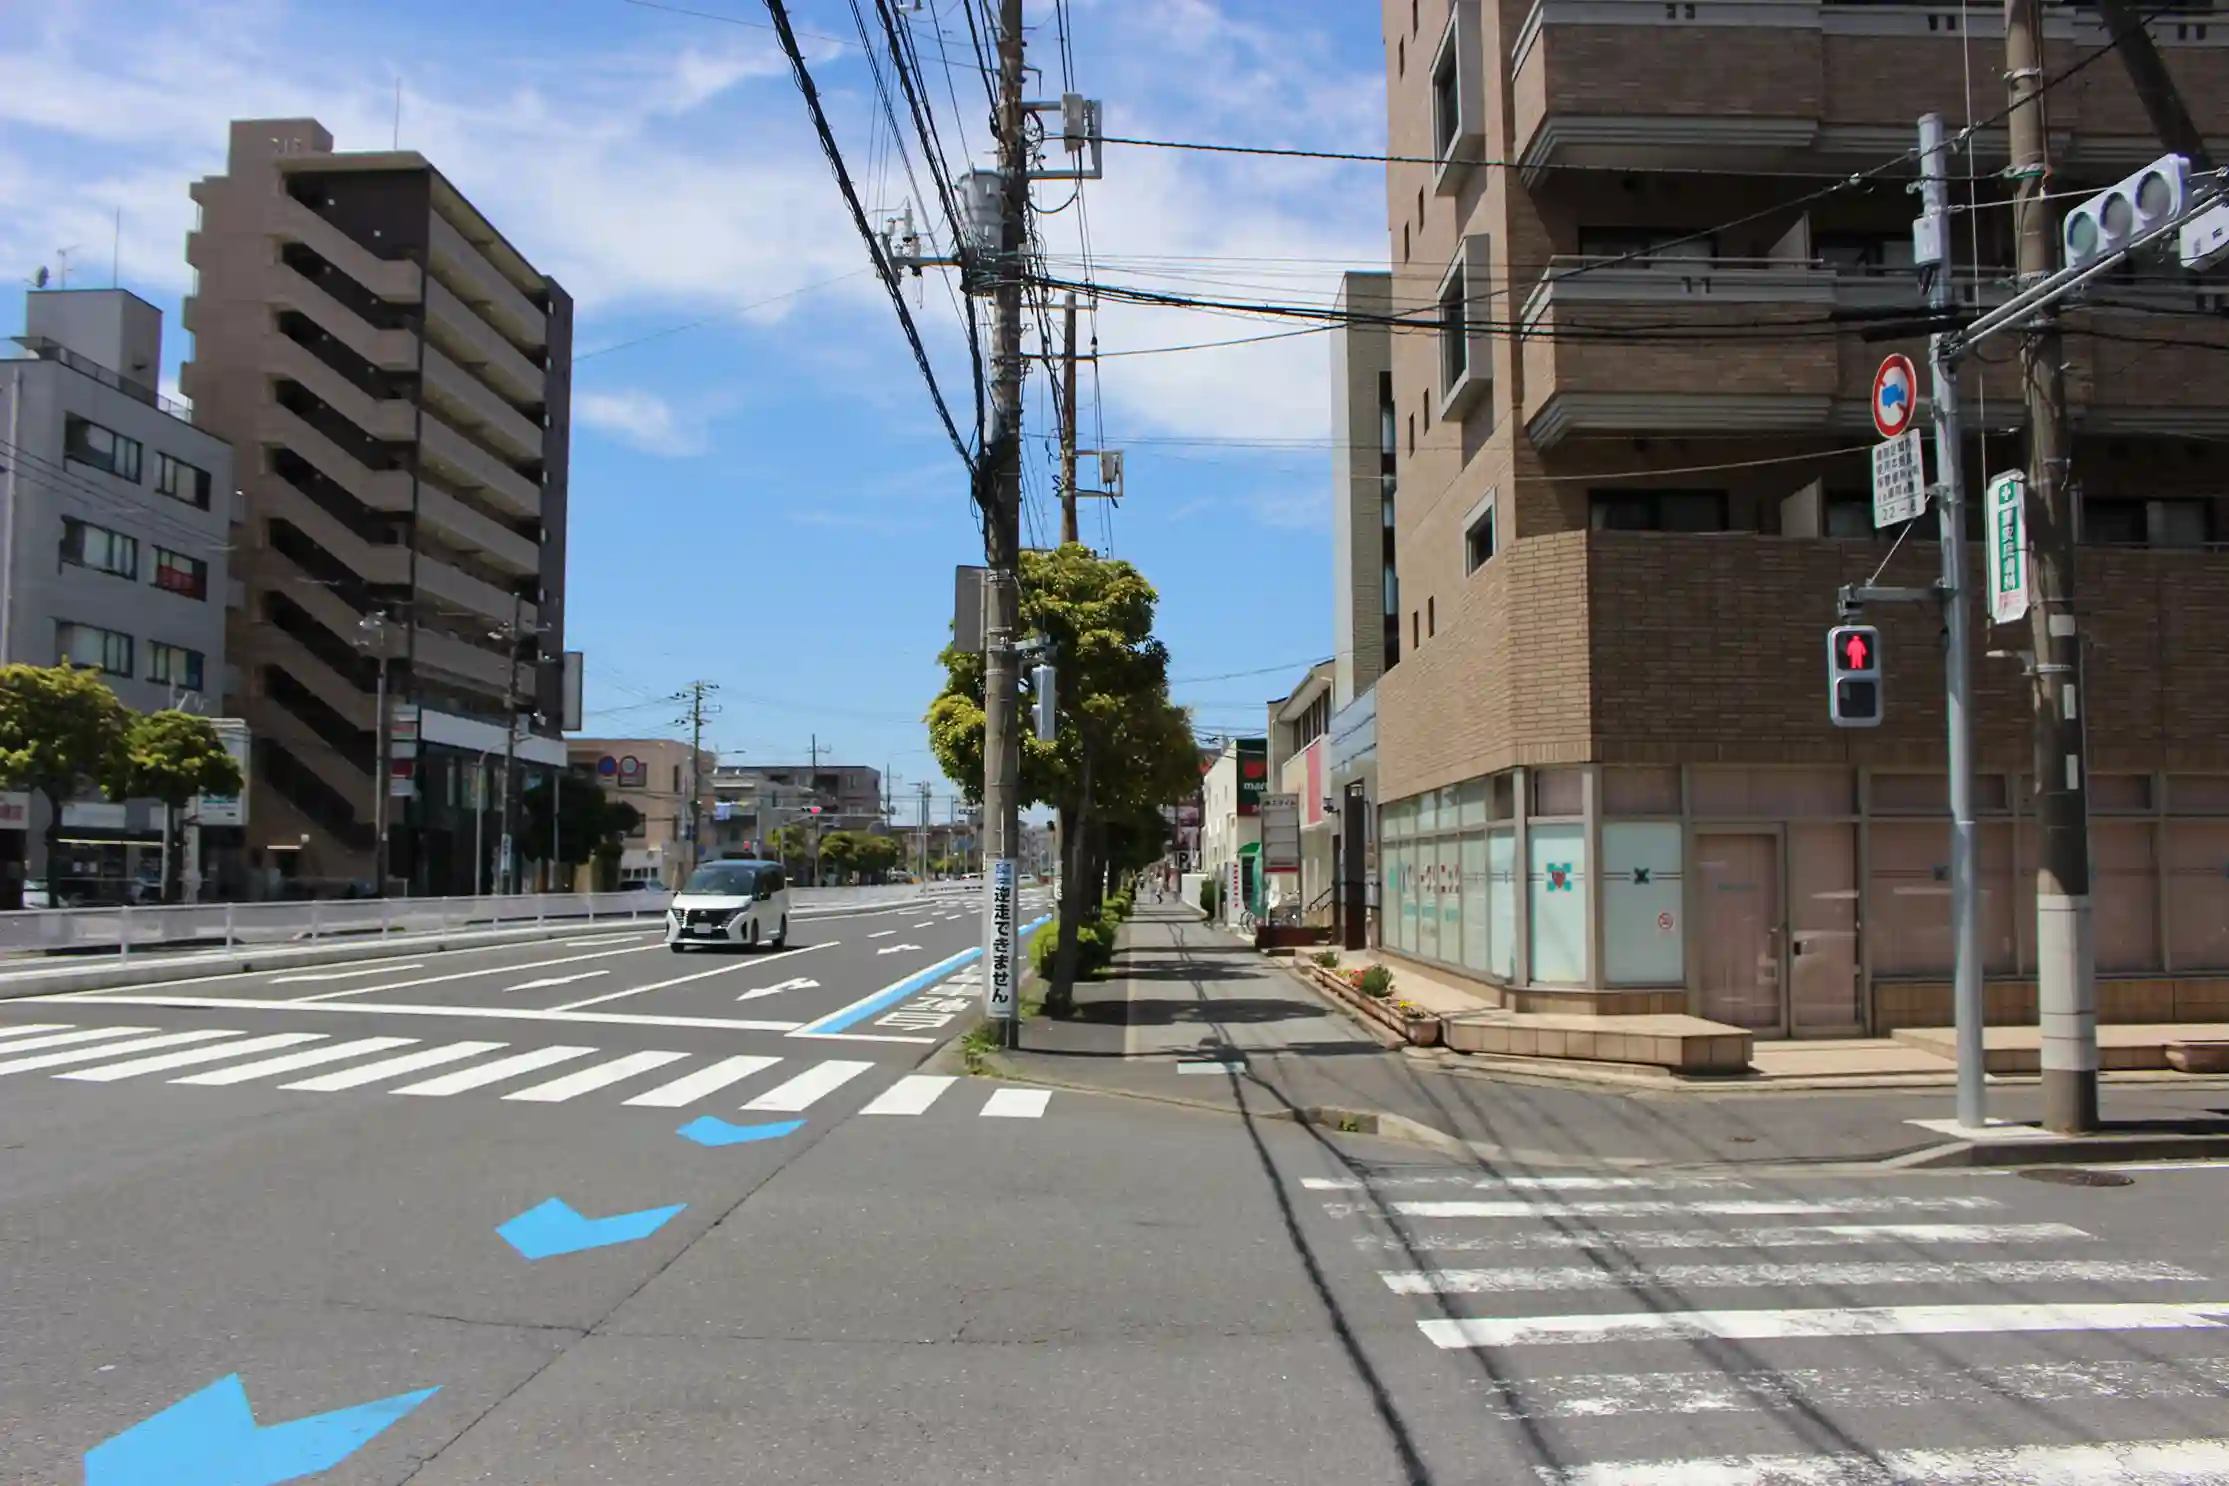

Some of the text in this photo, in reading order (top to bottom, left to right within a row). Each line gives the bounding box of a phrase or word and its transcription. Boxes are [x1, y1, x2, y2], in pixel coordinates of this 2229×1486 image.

[991, 887, 1010, 1003] 逆走できません
